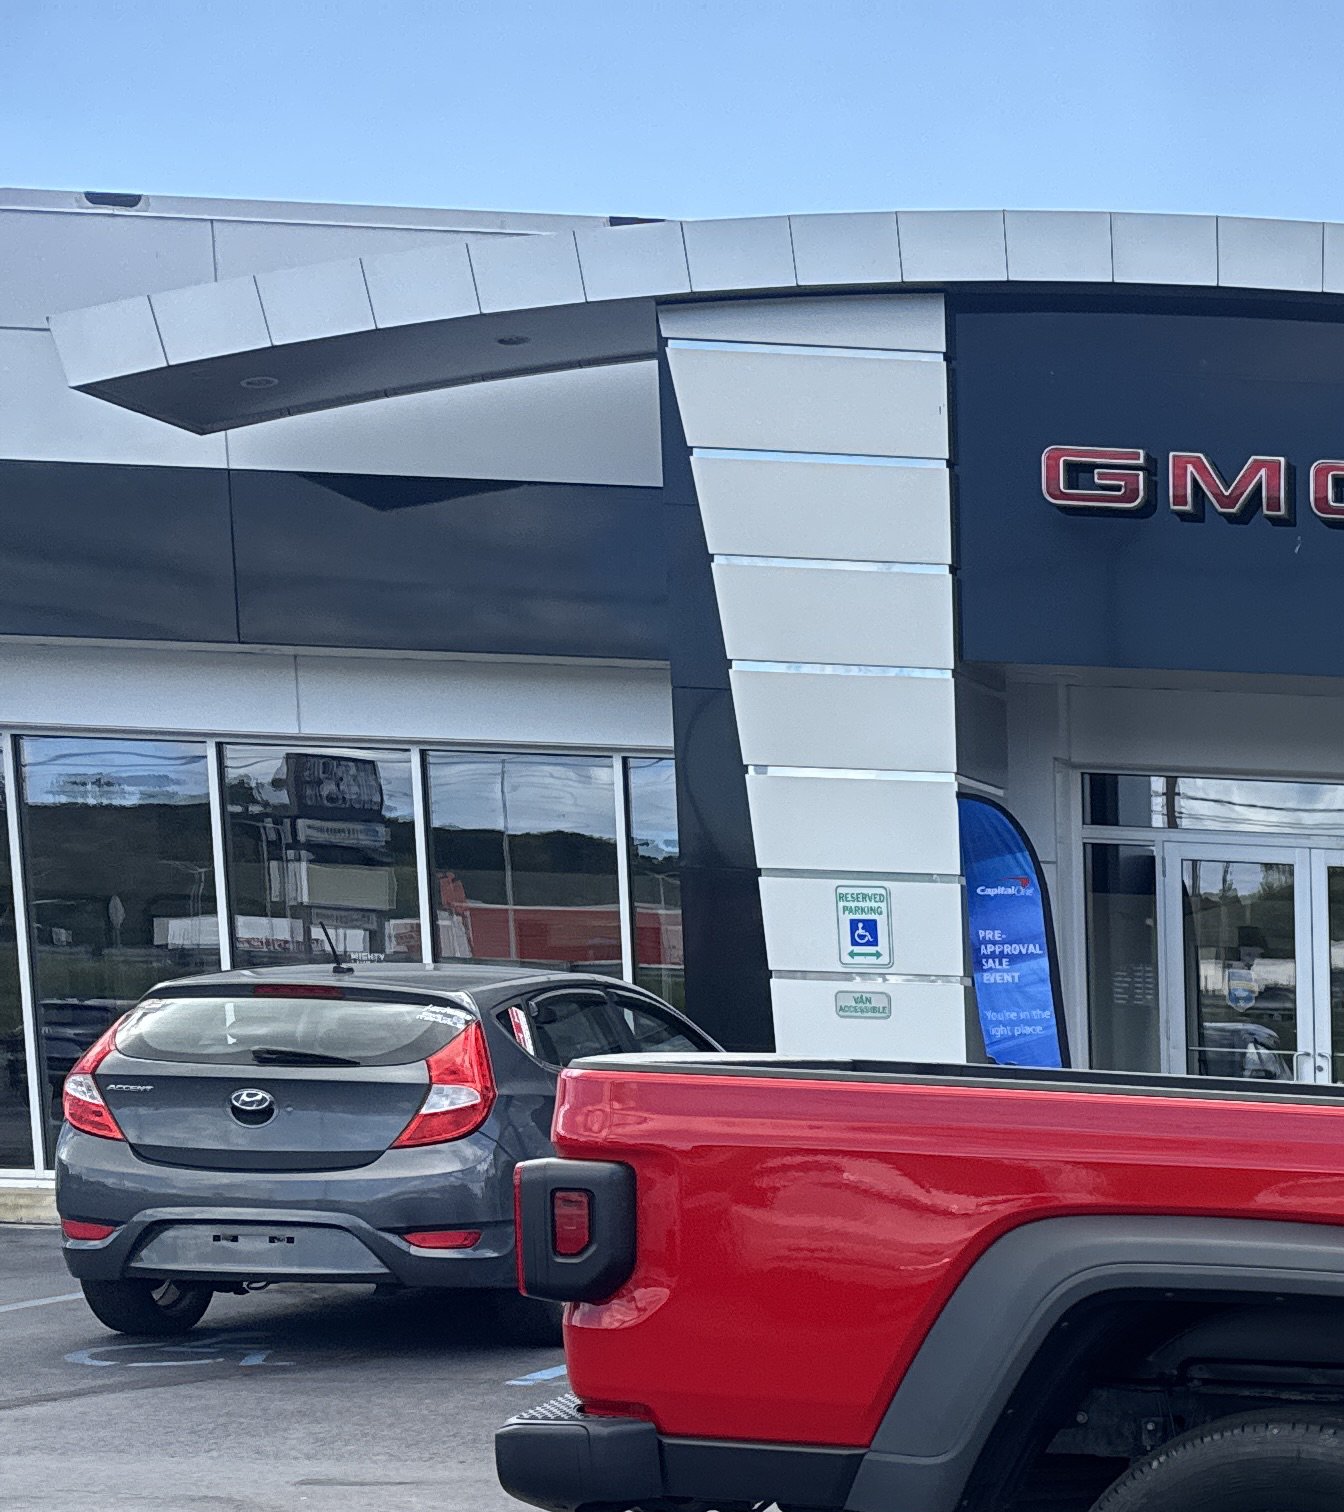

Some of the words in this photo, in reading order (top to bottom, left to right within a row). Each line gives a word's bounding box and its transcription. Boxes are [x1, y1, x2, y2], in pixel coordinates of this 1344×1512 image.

[838, 892, 885, 903] RESERVED
[842, 905, 883, 915] PARKING
[978, 929, 1006, 940] PRE-
[981, 943, 1043, 955] APPROVAL
[982, 958, 1010, 969] SALE
[983, 972, 1019, 983] EVENT
[853, 994, 872, 1004] VAN
[1032, 1009, 1050, 1019] the
[1014, 1024, 1043, 1036] place
[106, 1084, 154, 1092] ACCENT
